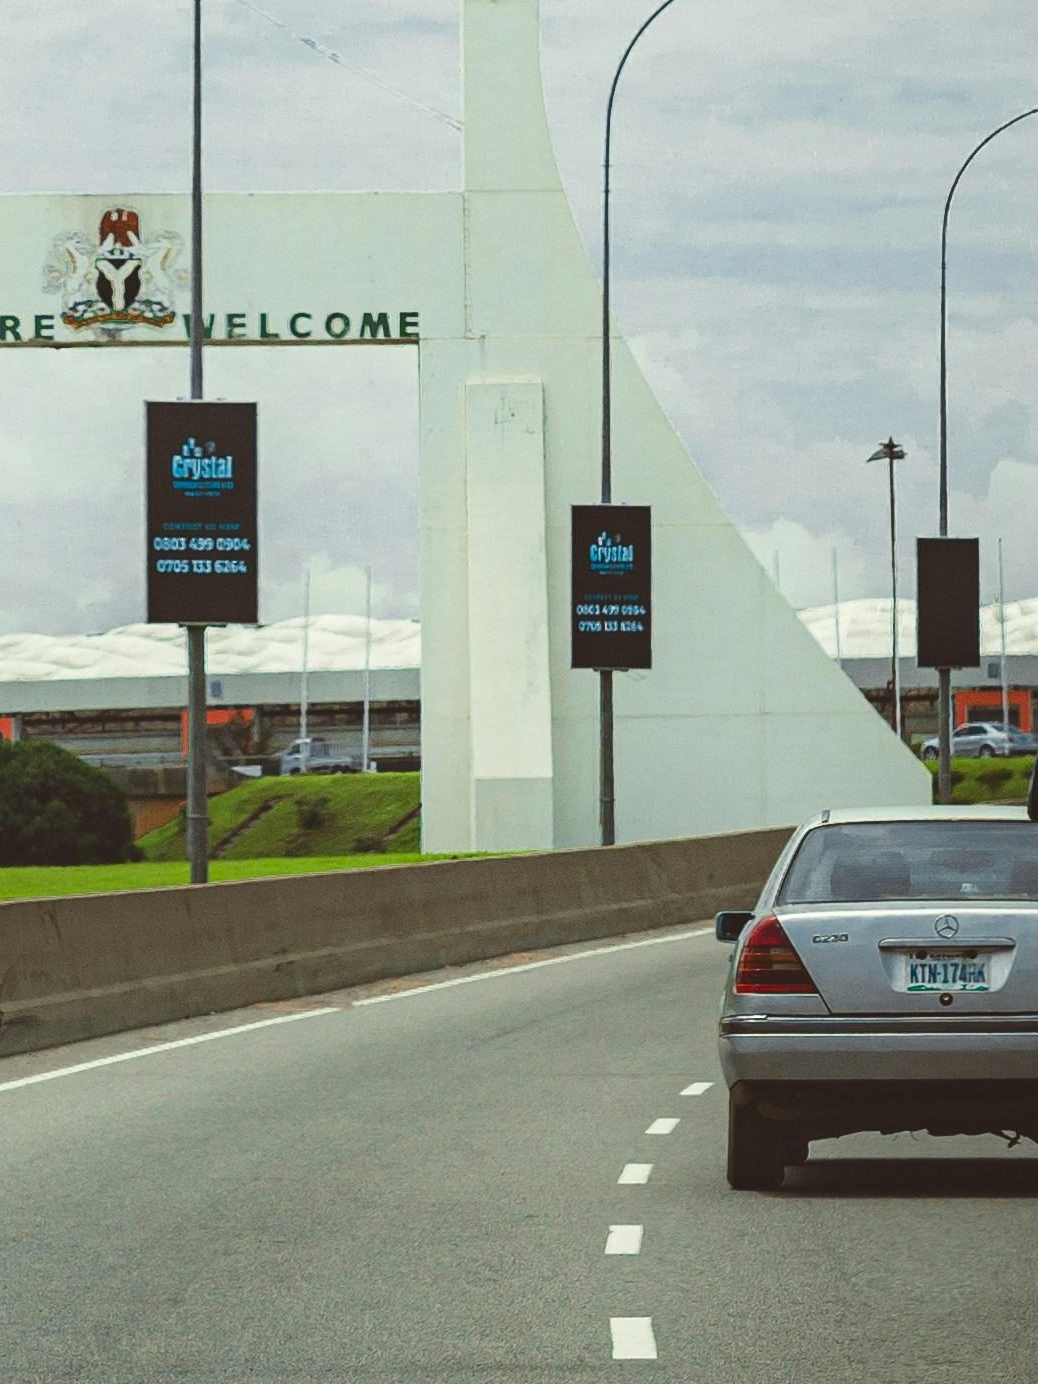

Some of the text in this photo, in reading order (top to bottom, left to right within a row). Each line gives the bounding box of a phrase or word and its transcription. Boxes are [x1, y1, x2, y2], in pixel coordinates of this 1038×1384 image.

[182, 312, 420, 339] WELCOME
[171, 455, 233, 480] Crystal
[589, 544, 634, 563] Crystal
